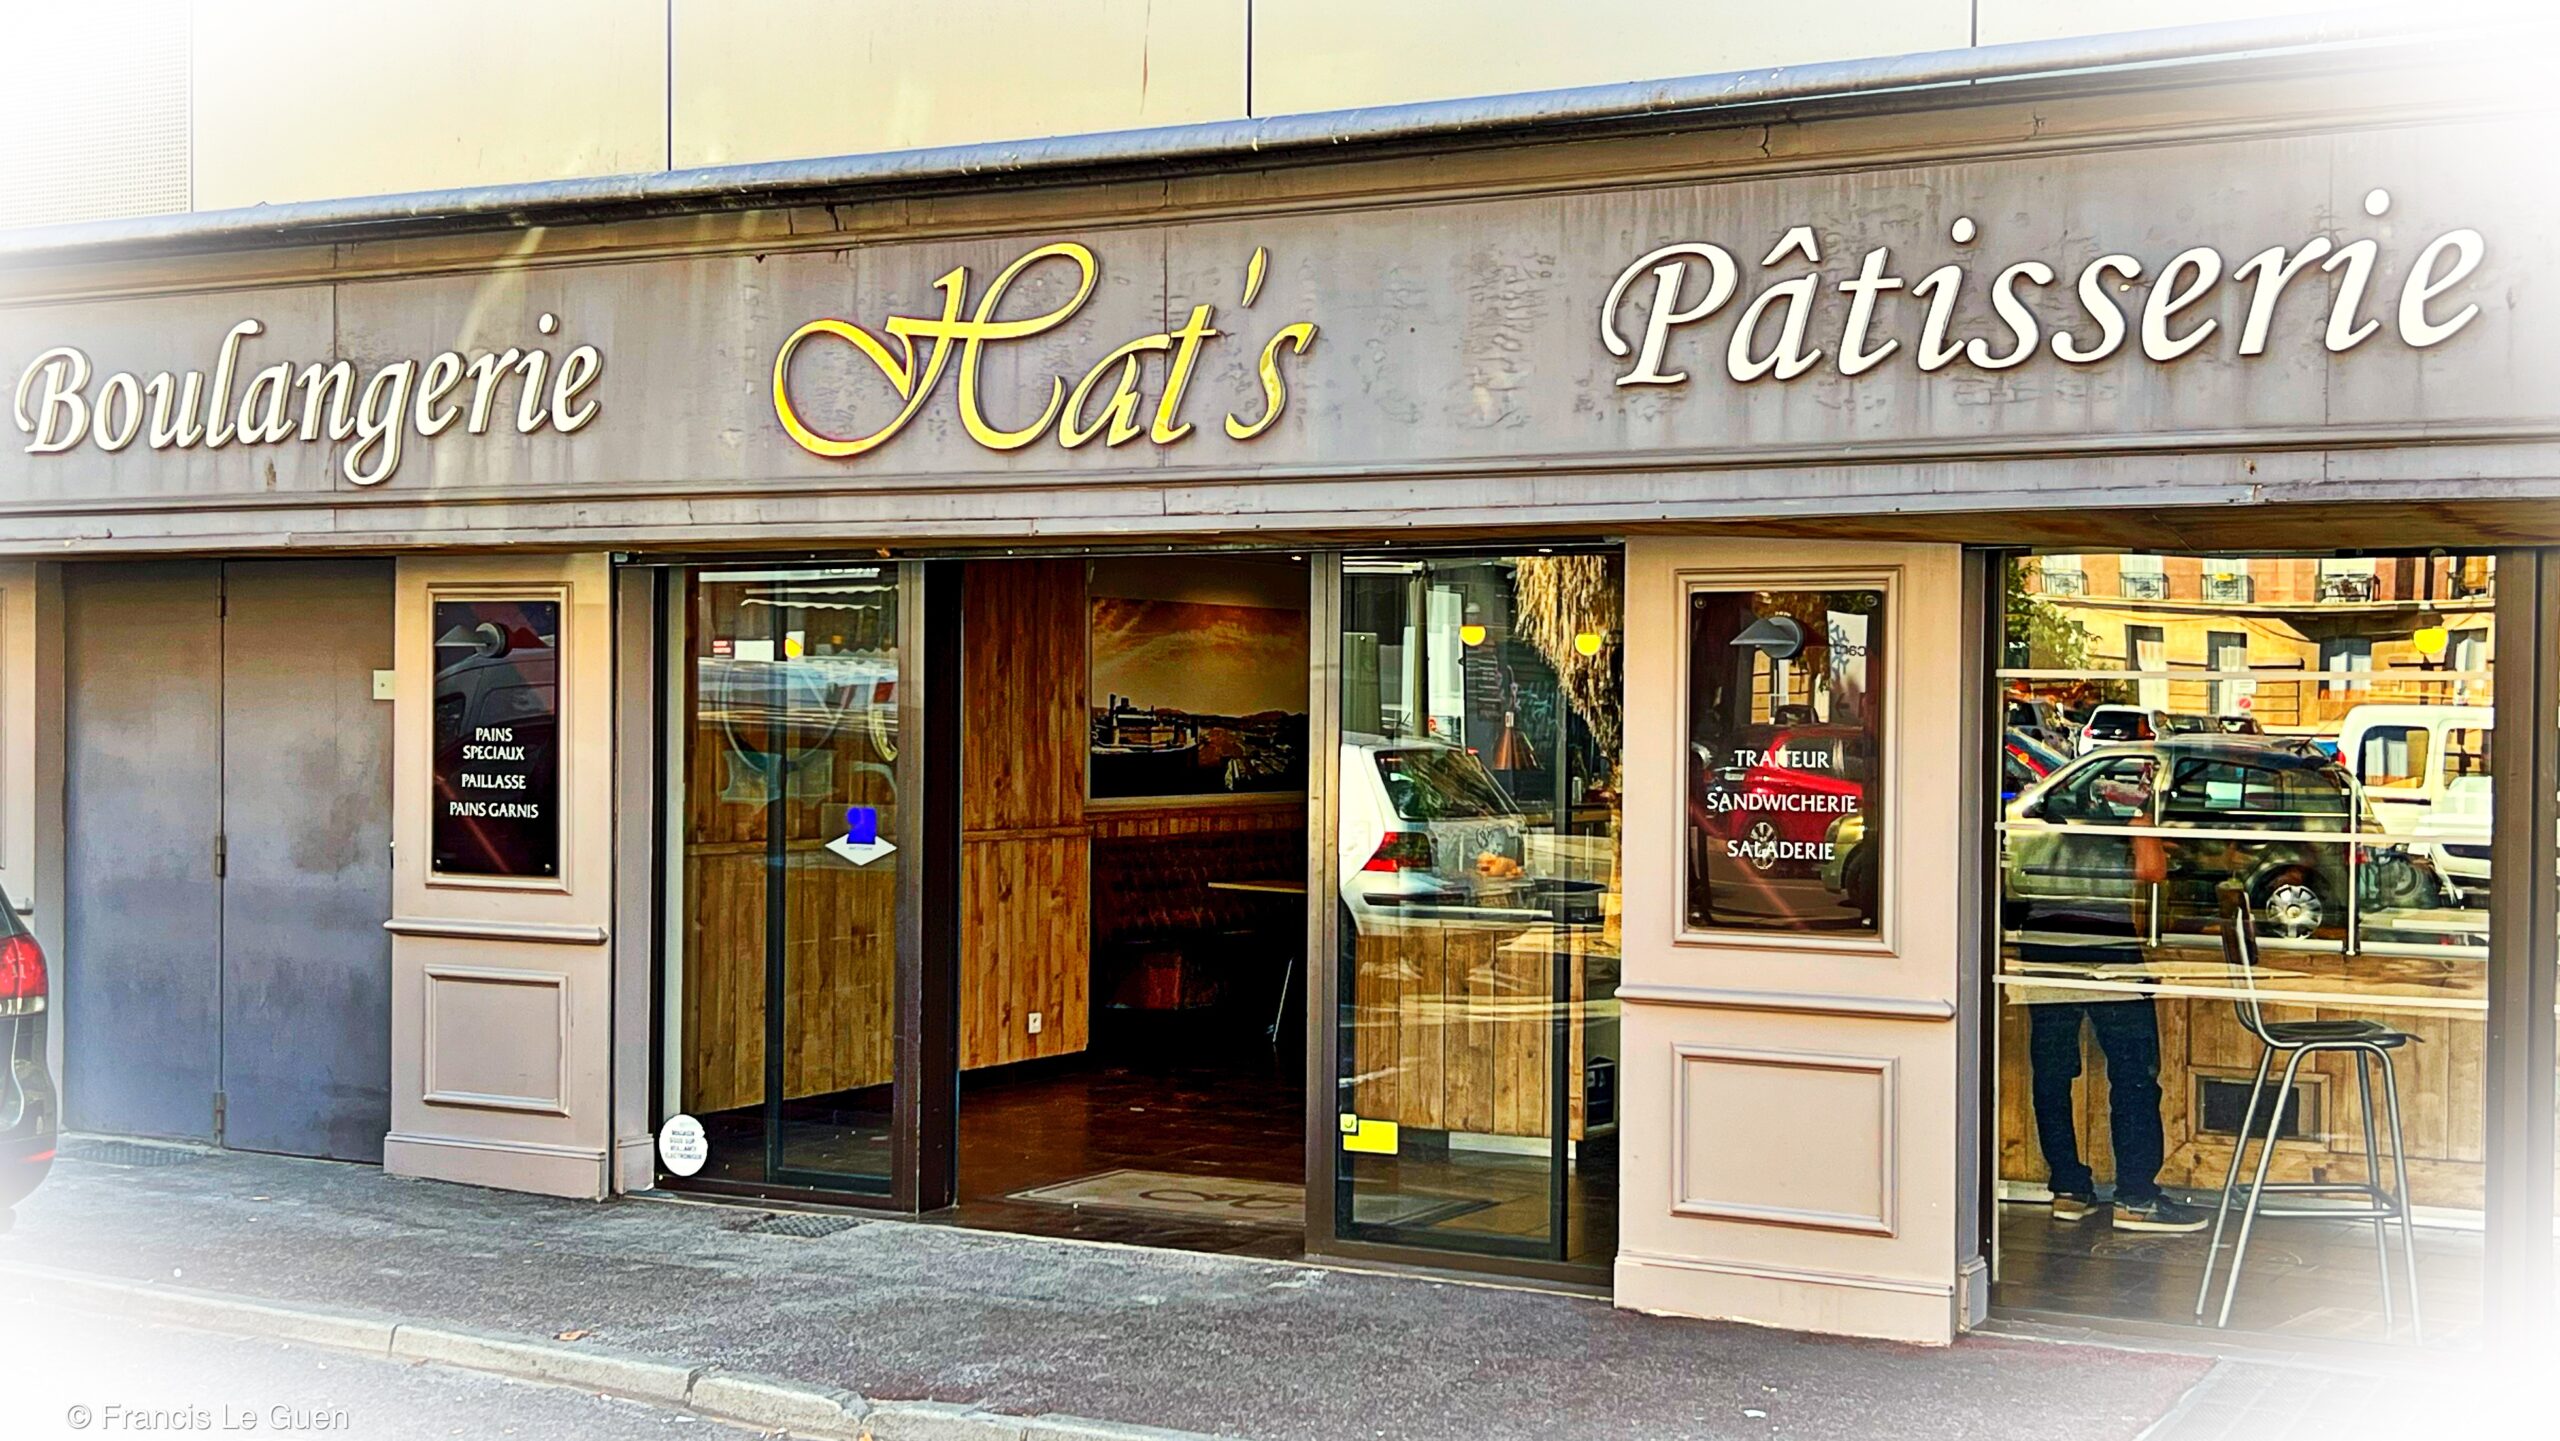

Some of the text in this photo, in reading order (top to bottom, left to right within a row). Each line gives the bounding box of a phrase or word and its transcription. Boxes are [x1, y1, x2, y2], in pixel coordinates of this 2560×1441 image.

[1600, 188, 2486, 387] Pâtisserie
[772, 242, 1318, 459] Hat's
[14, 312, 604, 486] Boulangerie
[475, 727, 513, 742] PAINS
[462, 745, 525, 760] SPECIAUX
[1734, 749, 1830, 769] TRAITEUR
[461, 773, 527, 789] PAILLASSE
[449, 801, 539, 818] PAINS GARNIS
[1706, 792, 1858, 813] SANDWICHERIE
[1727, 839, 1836, 861] SALADERIE
